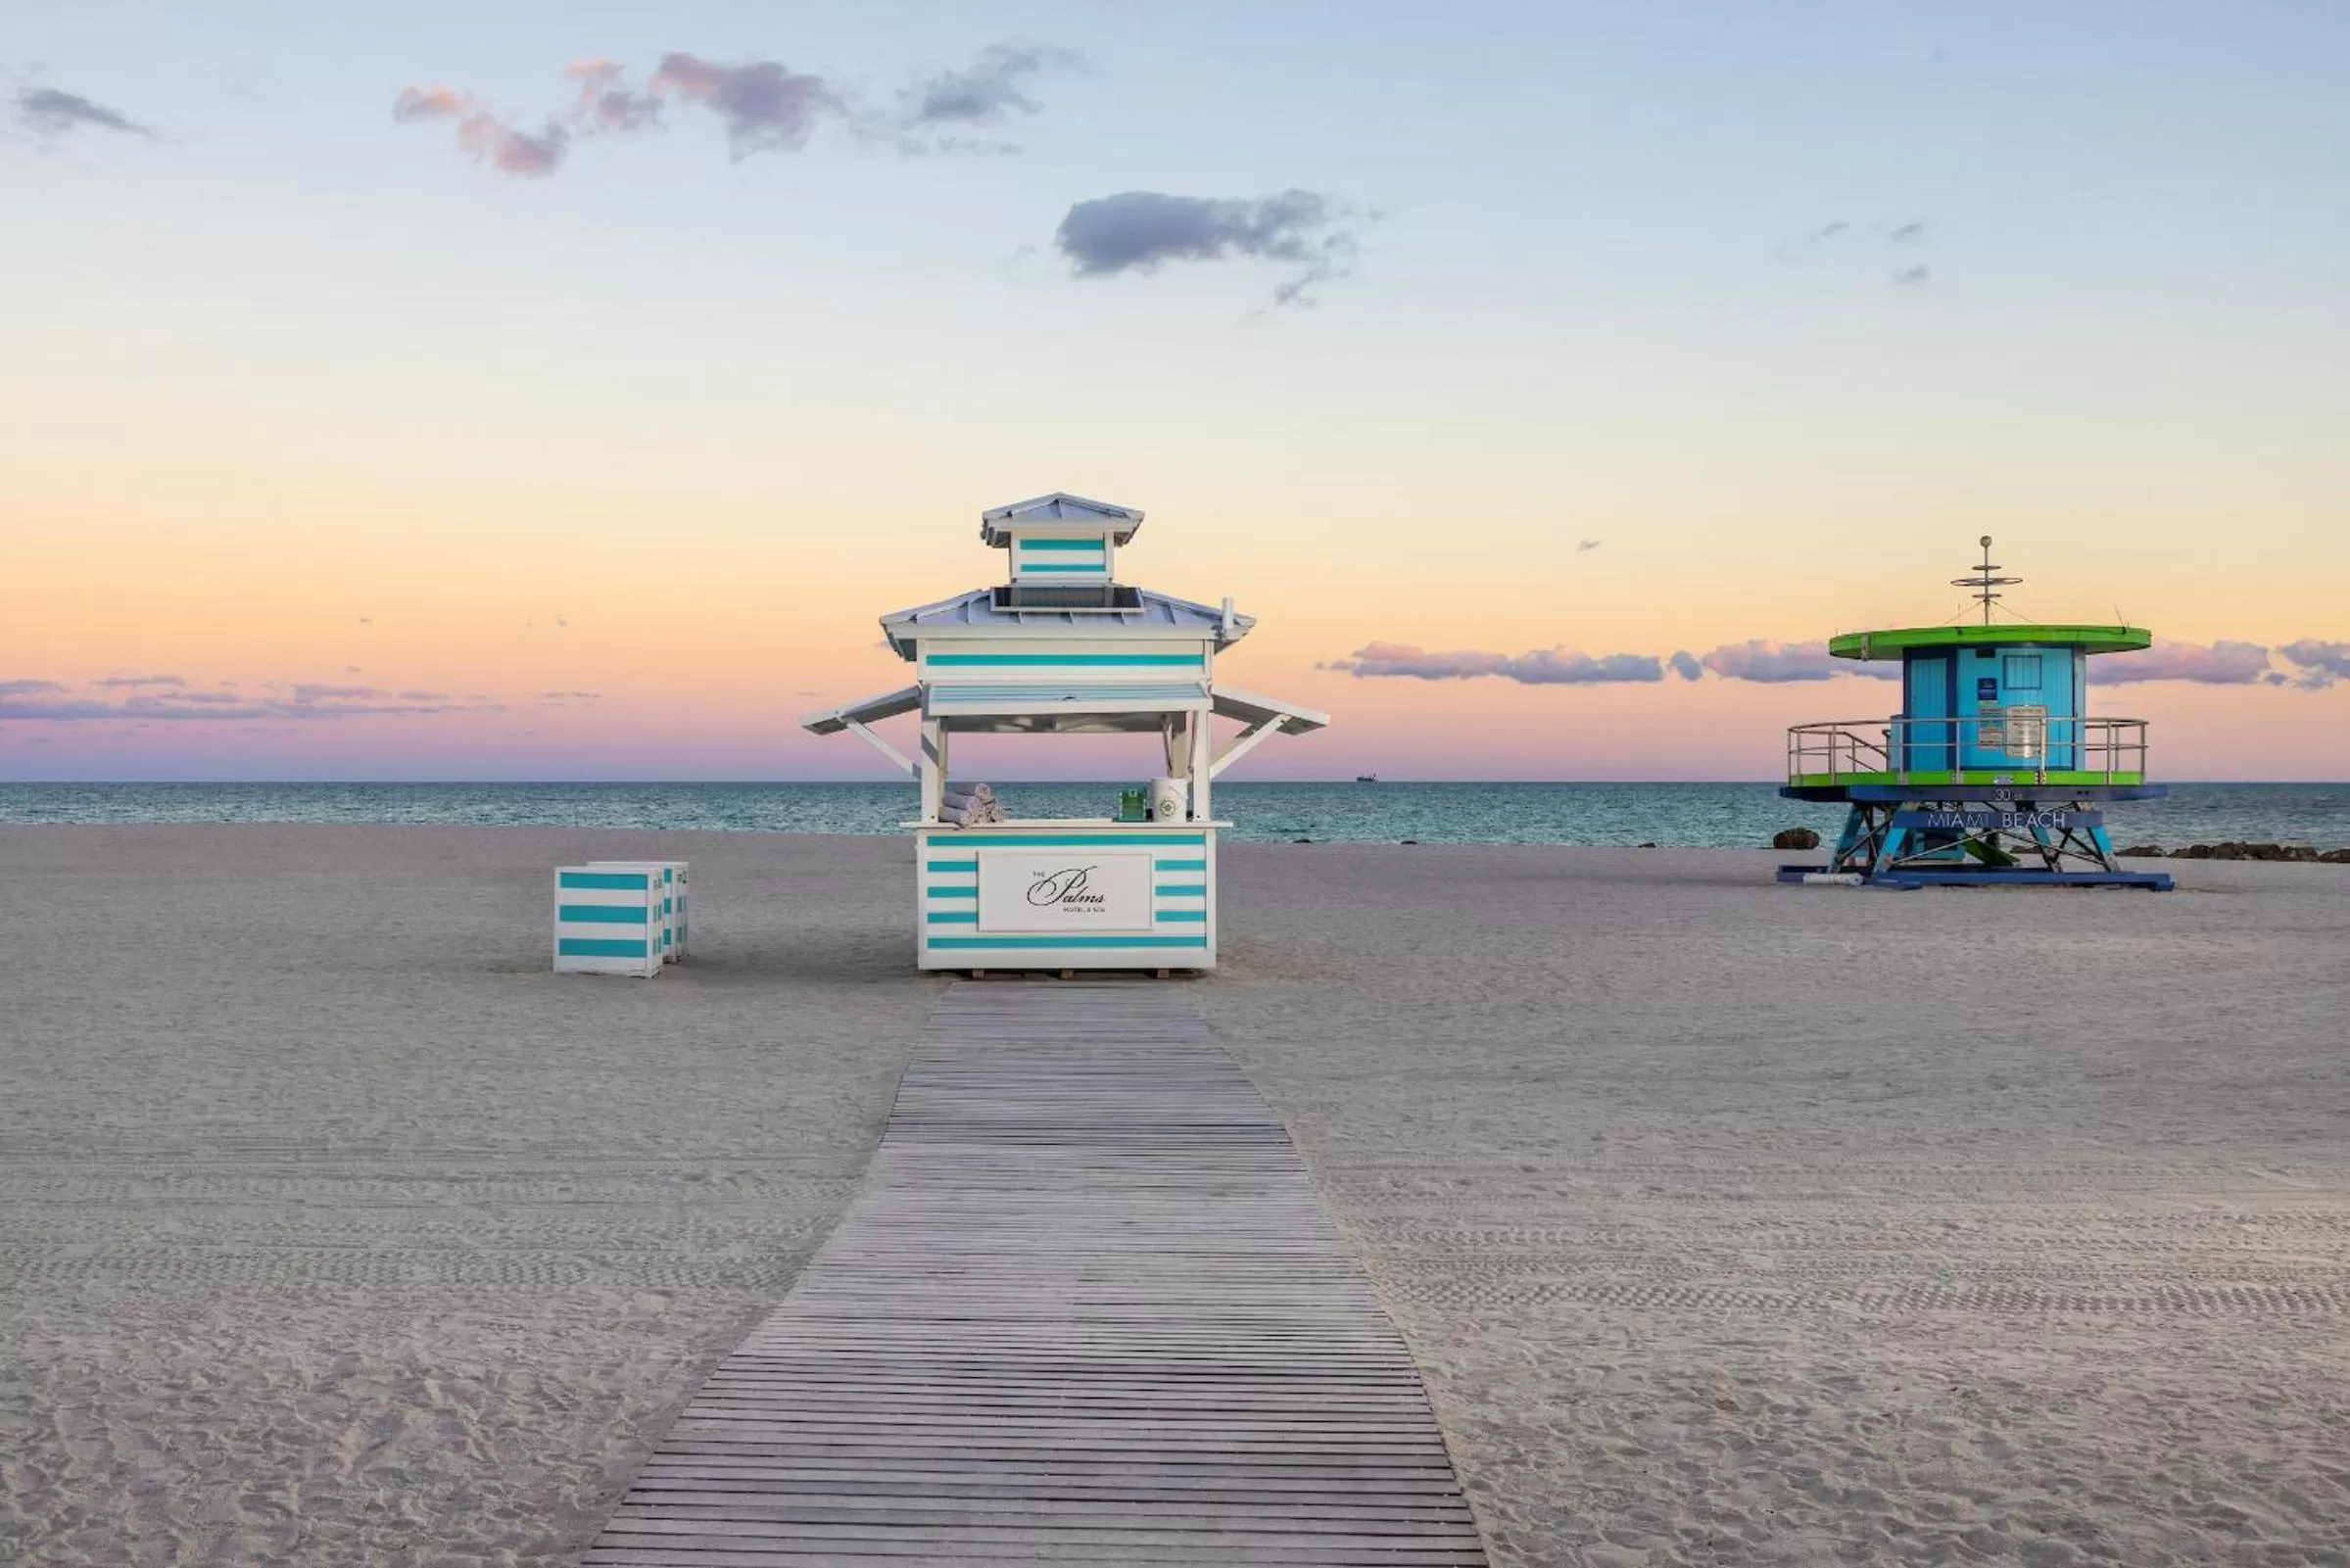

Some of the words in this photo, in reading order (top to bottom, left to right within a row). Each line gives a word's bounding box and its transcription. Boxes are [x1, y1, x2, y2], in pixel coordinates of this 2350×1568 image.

[1994, 787, 2011, 801] 30
[1928, 812, 1990, 828] MIAMI
[2001, 812, 2065, 828] BEACH
[1027, 865, 1105, 906] Palms
